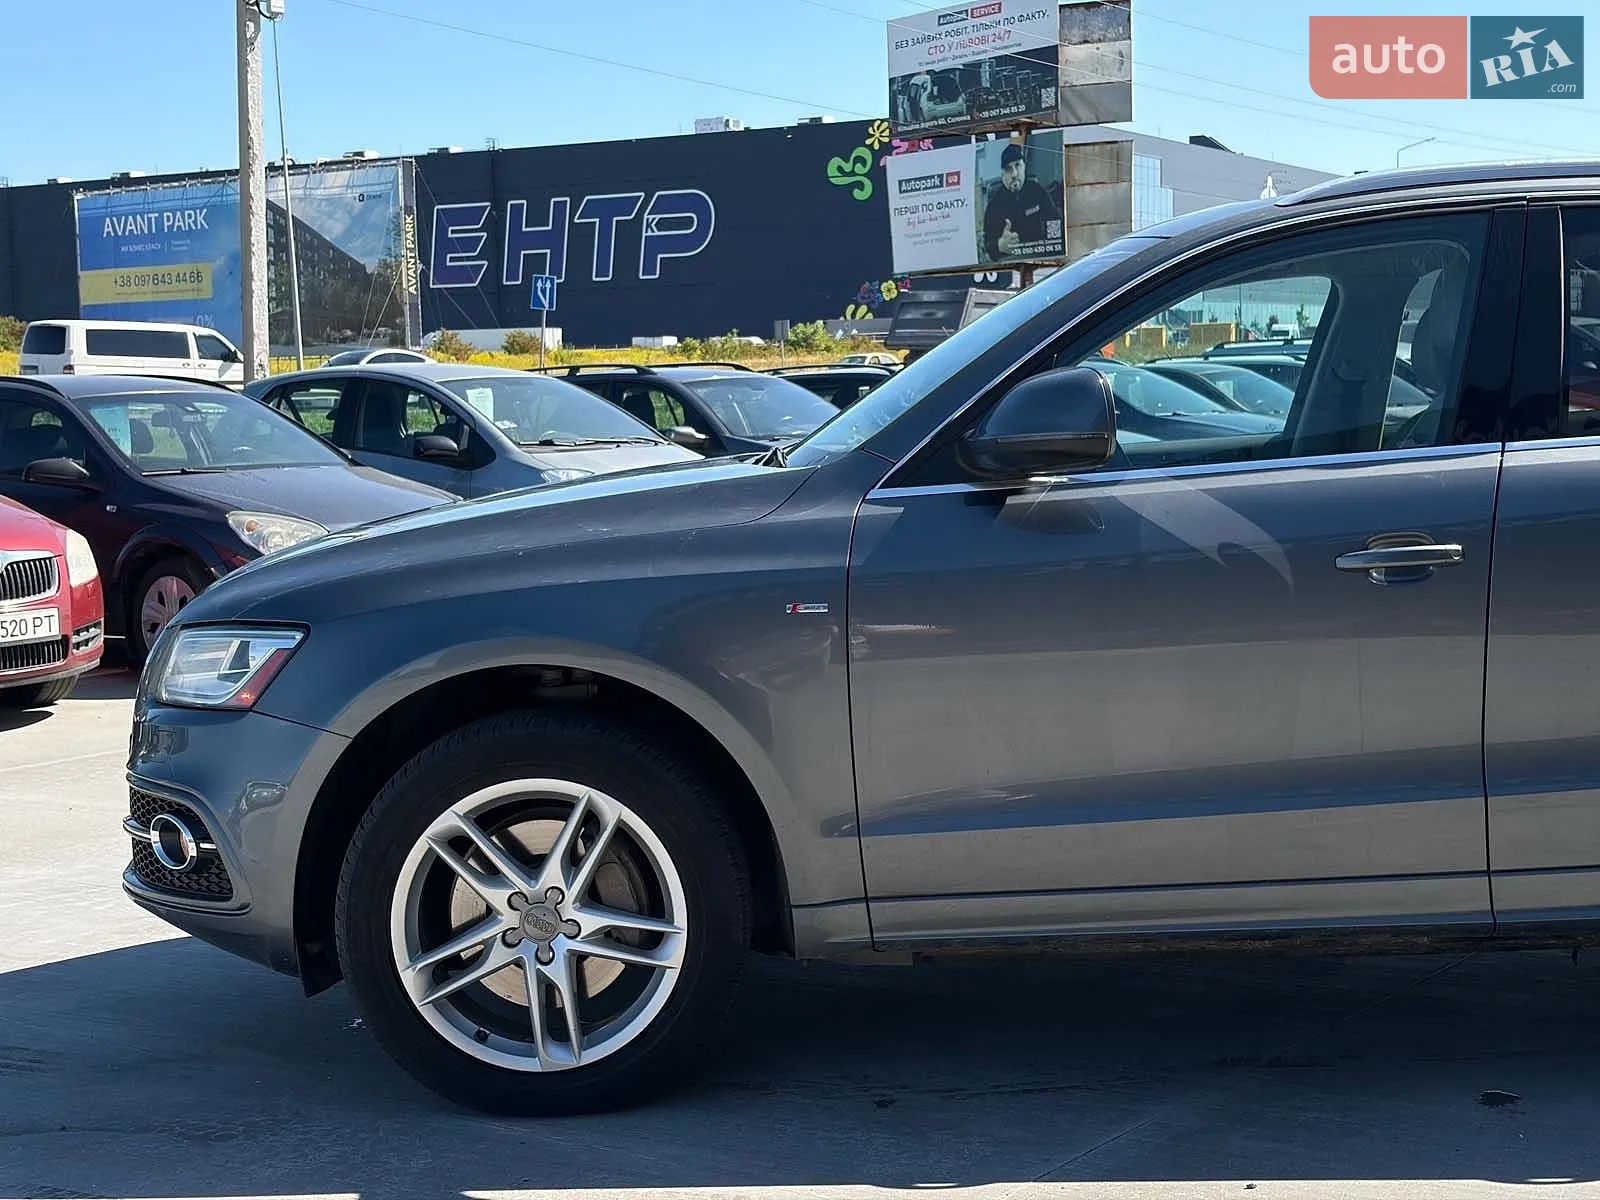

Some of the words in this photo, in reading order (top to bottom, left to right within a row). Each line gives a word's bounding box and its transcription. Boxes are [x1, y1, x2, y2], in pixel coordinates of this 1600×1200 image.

[895, 39, 909, 50] БЕЗ
[911, 33, 944, 46] ЗАЙВИХ
[944, 26, 970, 41] РОБІТ.
[971, 19, 1001, 34] ТІЛЬКИ
[1003, 16, 1016, 27] ПО
[1017, 8, 1049, 23] ФАКТУ.
[927, 44, 946, 56] СТО
[948, 41, 955, 51] У
[991, 29, 1012, 43] 24/7
[901, 174, 941, 192] Autopark
[893, 205, 920, 217] ПЕРШІ
[921, 203, 934, 213] ПО
[936, 198, 968, 210] ФАКТУ.
[103, 213, 159, 238] AVANT
[163, 208, 209, 233] PARK
[405, 214, 415, 248] PARK
[113, 275, 132, 288] +38
[406, 252, 417, 295] AVANT
[0, 618, 28, 639] 520
[32, 614, 55, 635] PT
